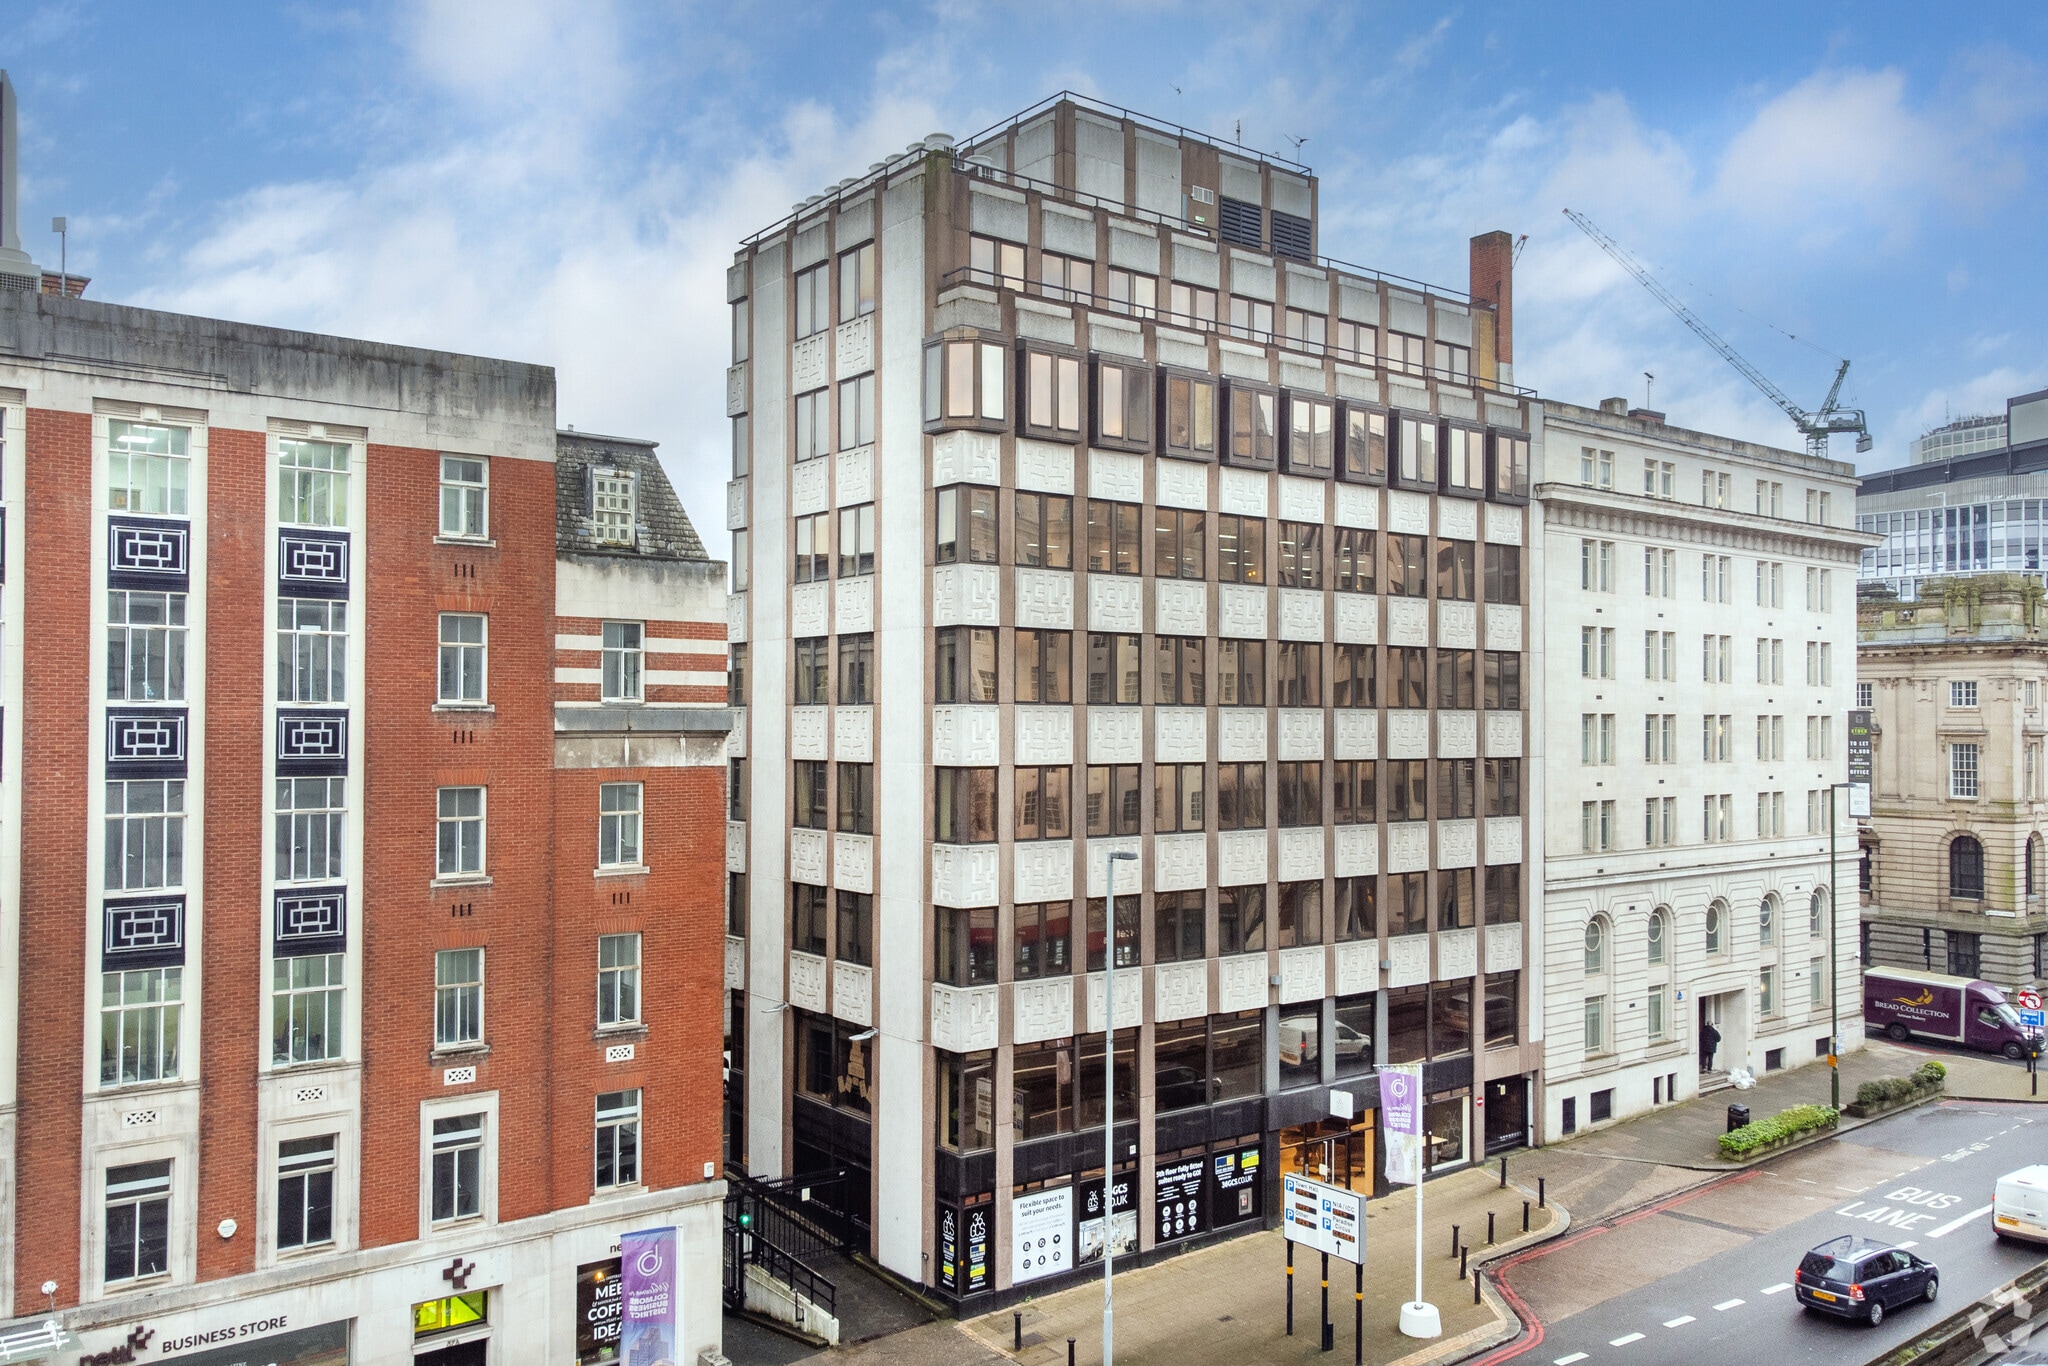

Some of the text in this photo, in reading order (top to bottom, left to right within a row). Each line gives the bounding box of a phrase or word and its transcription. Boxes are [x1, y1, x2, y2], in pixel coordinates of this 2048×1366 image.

[1874, 1000, 1950, 1018] BREAD COLLECTION
[1020, 1200, 1042, 1209] Flexible
[1043, 1196, 1057, 1204] space
[1884, 1186, 1962, 1208] BUS
[972, 1212, 984, 1225] 36
[1033, 1207, 1045, 1216] your
[1835, 1201, 1936, 1230] LANE
[943, 1220, 954, 1236] GCS
[1332, 1216, 1353, 1227] Paradise
[970, 1223, 986, 1237] GCS
[162, 1316, 287, 1353] BUSINESS STORE
